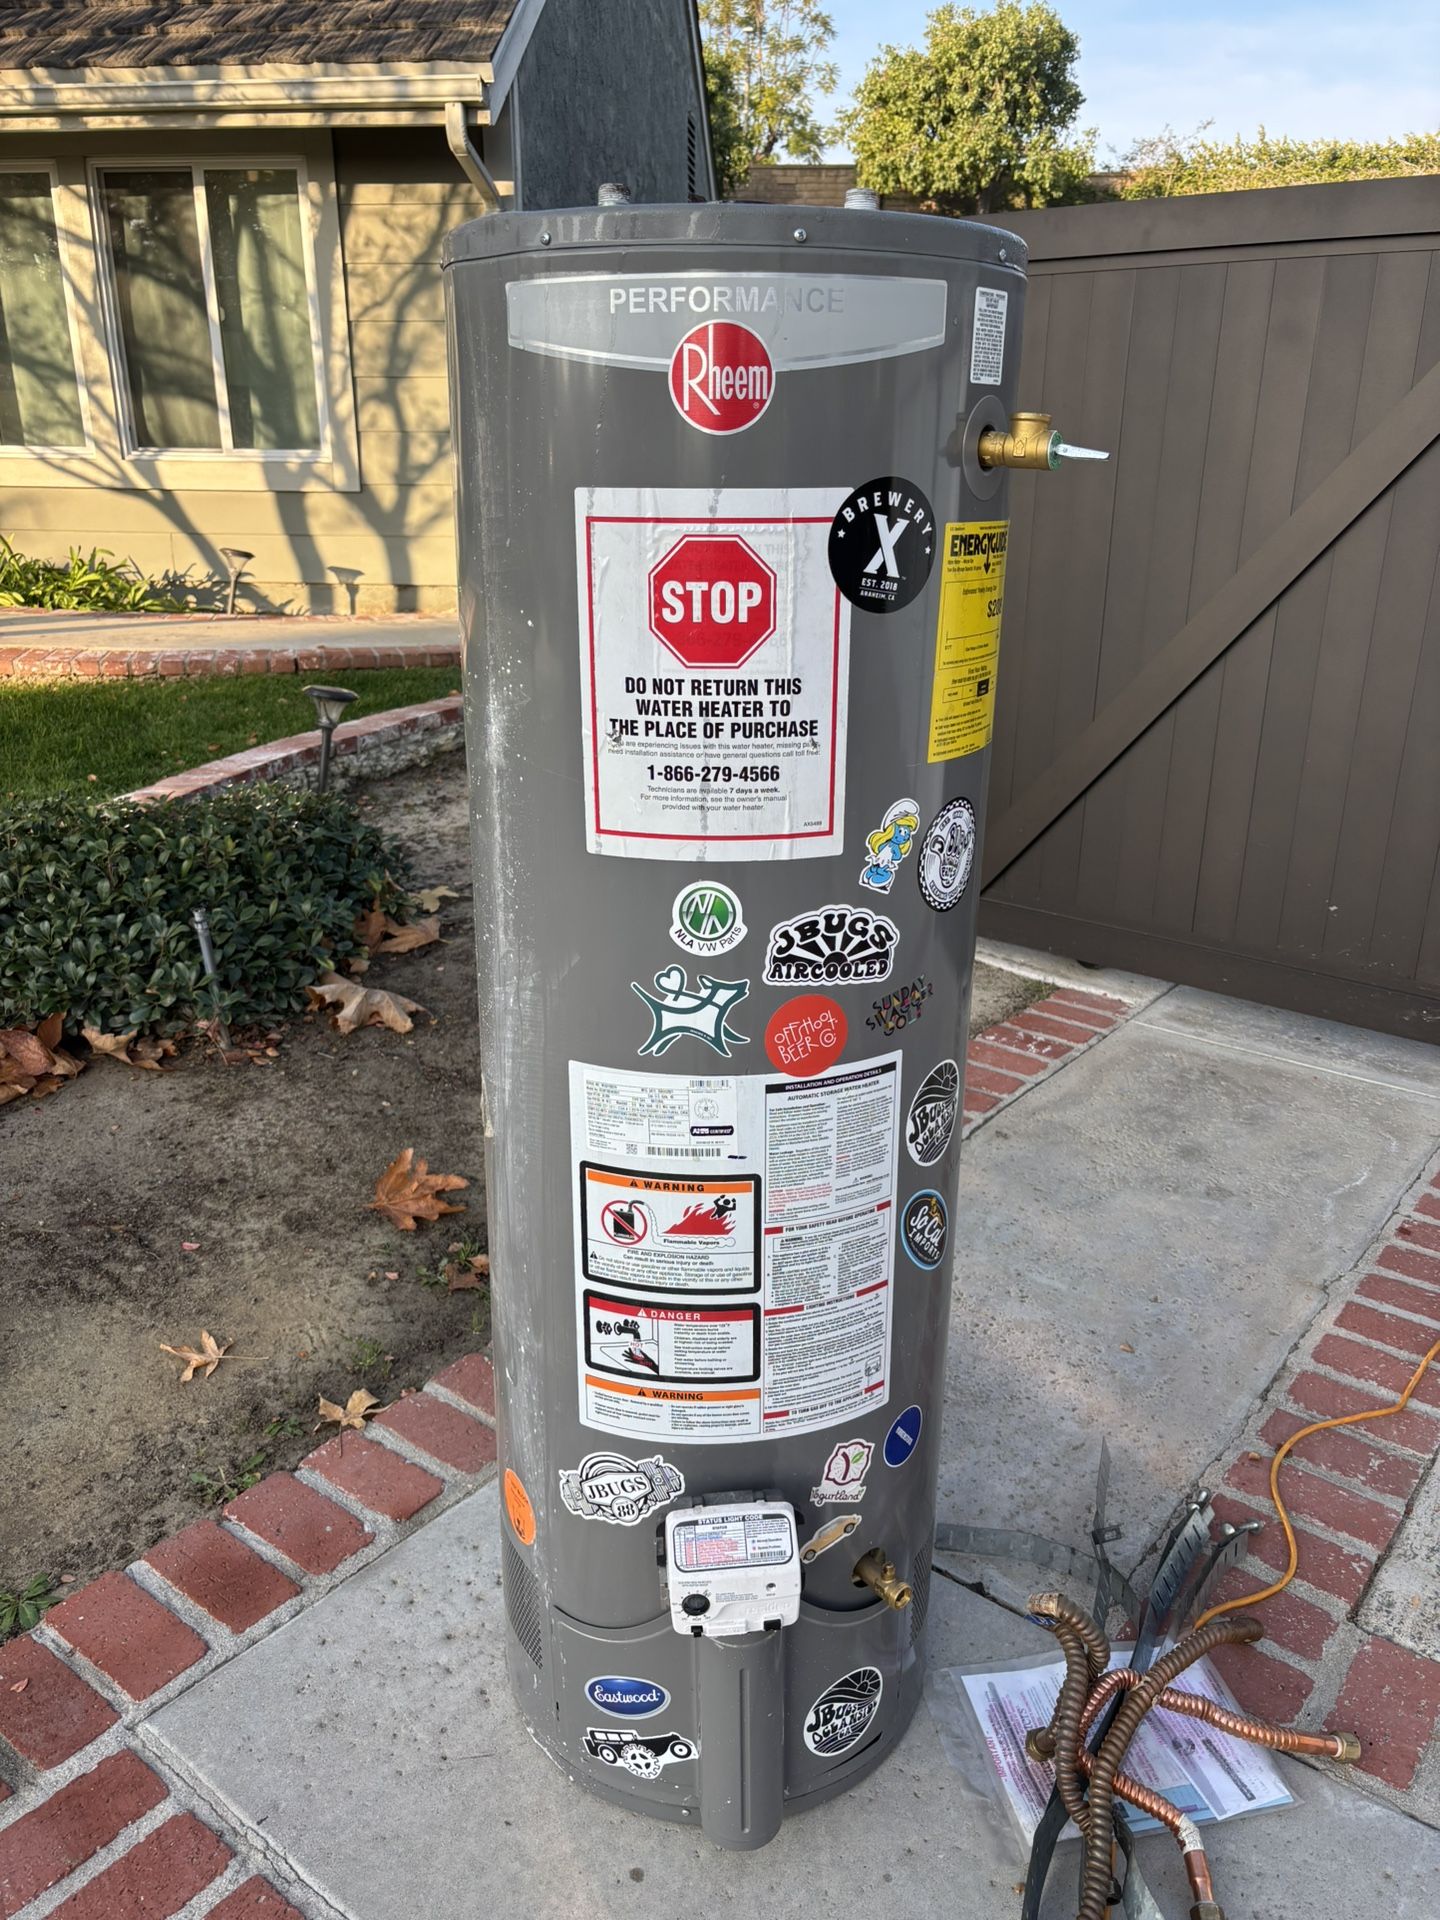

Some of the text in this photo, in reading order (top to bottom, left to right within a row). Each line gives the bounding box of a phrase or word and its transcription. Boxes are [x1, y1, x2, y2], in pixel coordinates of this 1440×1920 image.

[609, 286, 844, 314] PERFORMANCE
[683, 324, 768, 415] Rheem
[842, 491, 932, 535] BREWERY
[863, 513, 910, 578] X
[662, 580, 762, 624] STOP
[625, 677, 802, 696] DO NOT RETURN THIS
[636, 699, 791, 718] WATER HEATER TO
[609, 718, 818, 739] THE PLACE OF PURCHASE
[647, 764, 780, 783] 1-866-279-4566
[675, 926, 742, 952] NLA VW Parts
[775, 914, 894, 955] JBUGS
[769, 960, 889, 980] AIRCOOLED
[778, 1036, 819, 1064] BEER
[785, 1081, 822, 1091] INSTALLATION
[836, 1073, 863, 1084] OPERATION
[863, 1068, 882, 1078] DETAILS
[787, 1080, 880, 1101] AUTOMATIC STORAGE WATER HEATER
[644, 1181, 705, 1192] WARNING
[908, 1228, 940, 1260] IMPORTS
[651, 1310, 701, 1321] DANGER
[652, 1390, 704, 1401] WARNING
[587, 1476, 648, 1499] JBUGS
[811, 1488, 860, 1505] Yogurtland
[617, 1503, 635, 1518] 88
[594, 1685, 659, 1703] Eastwood
